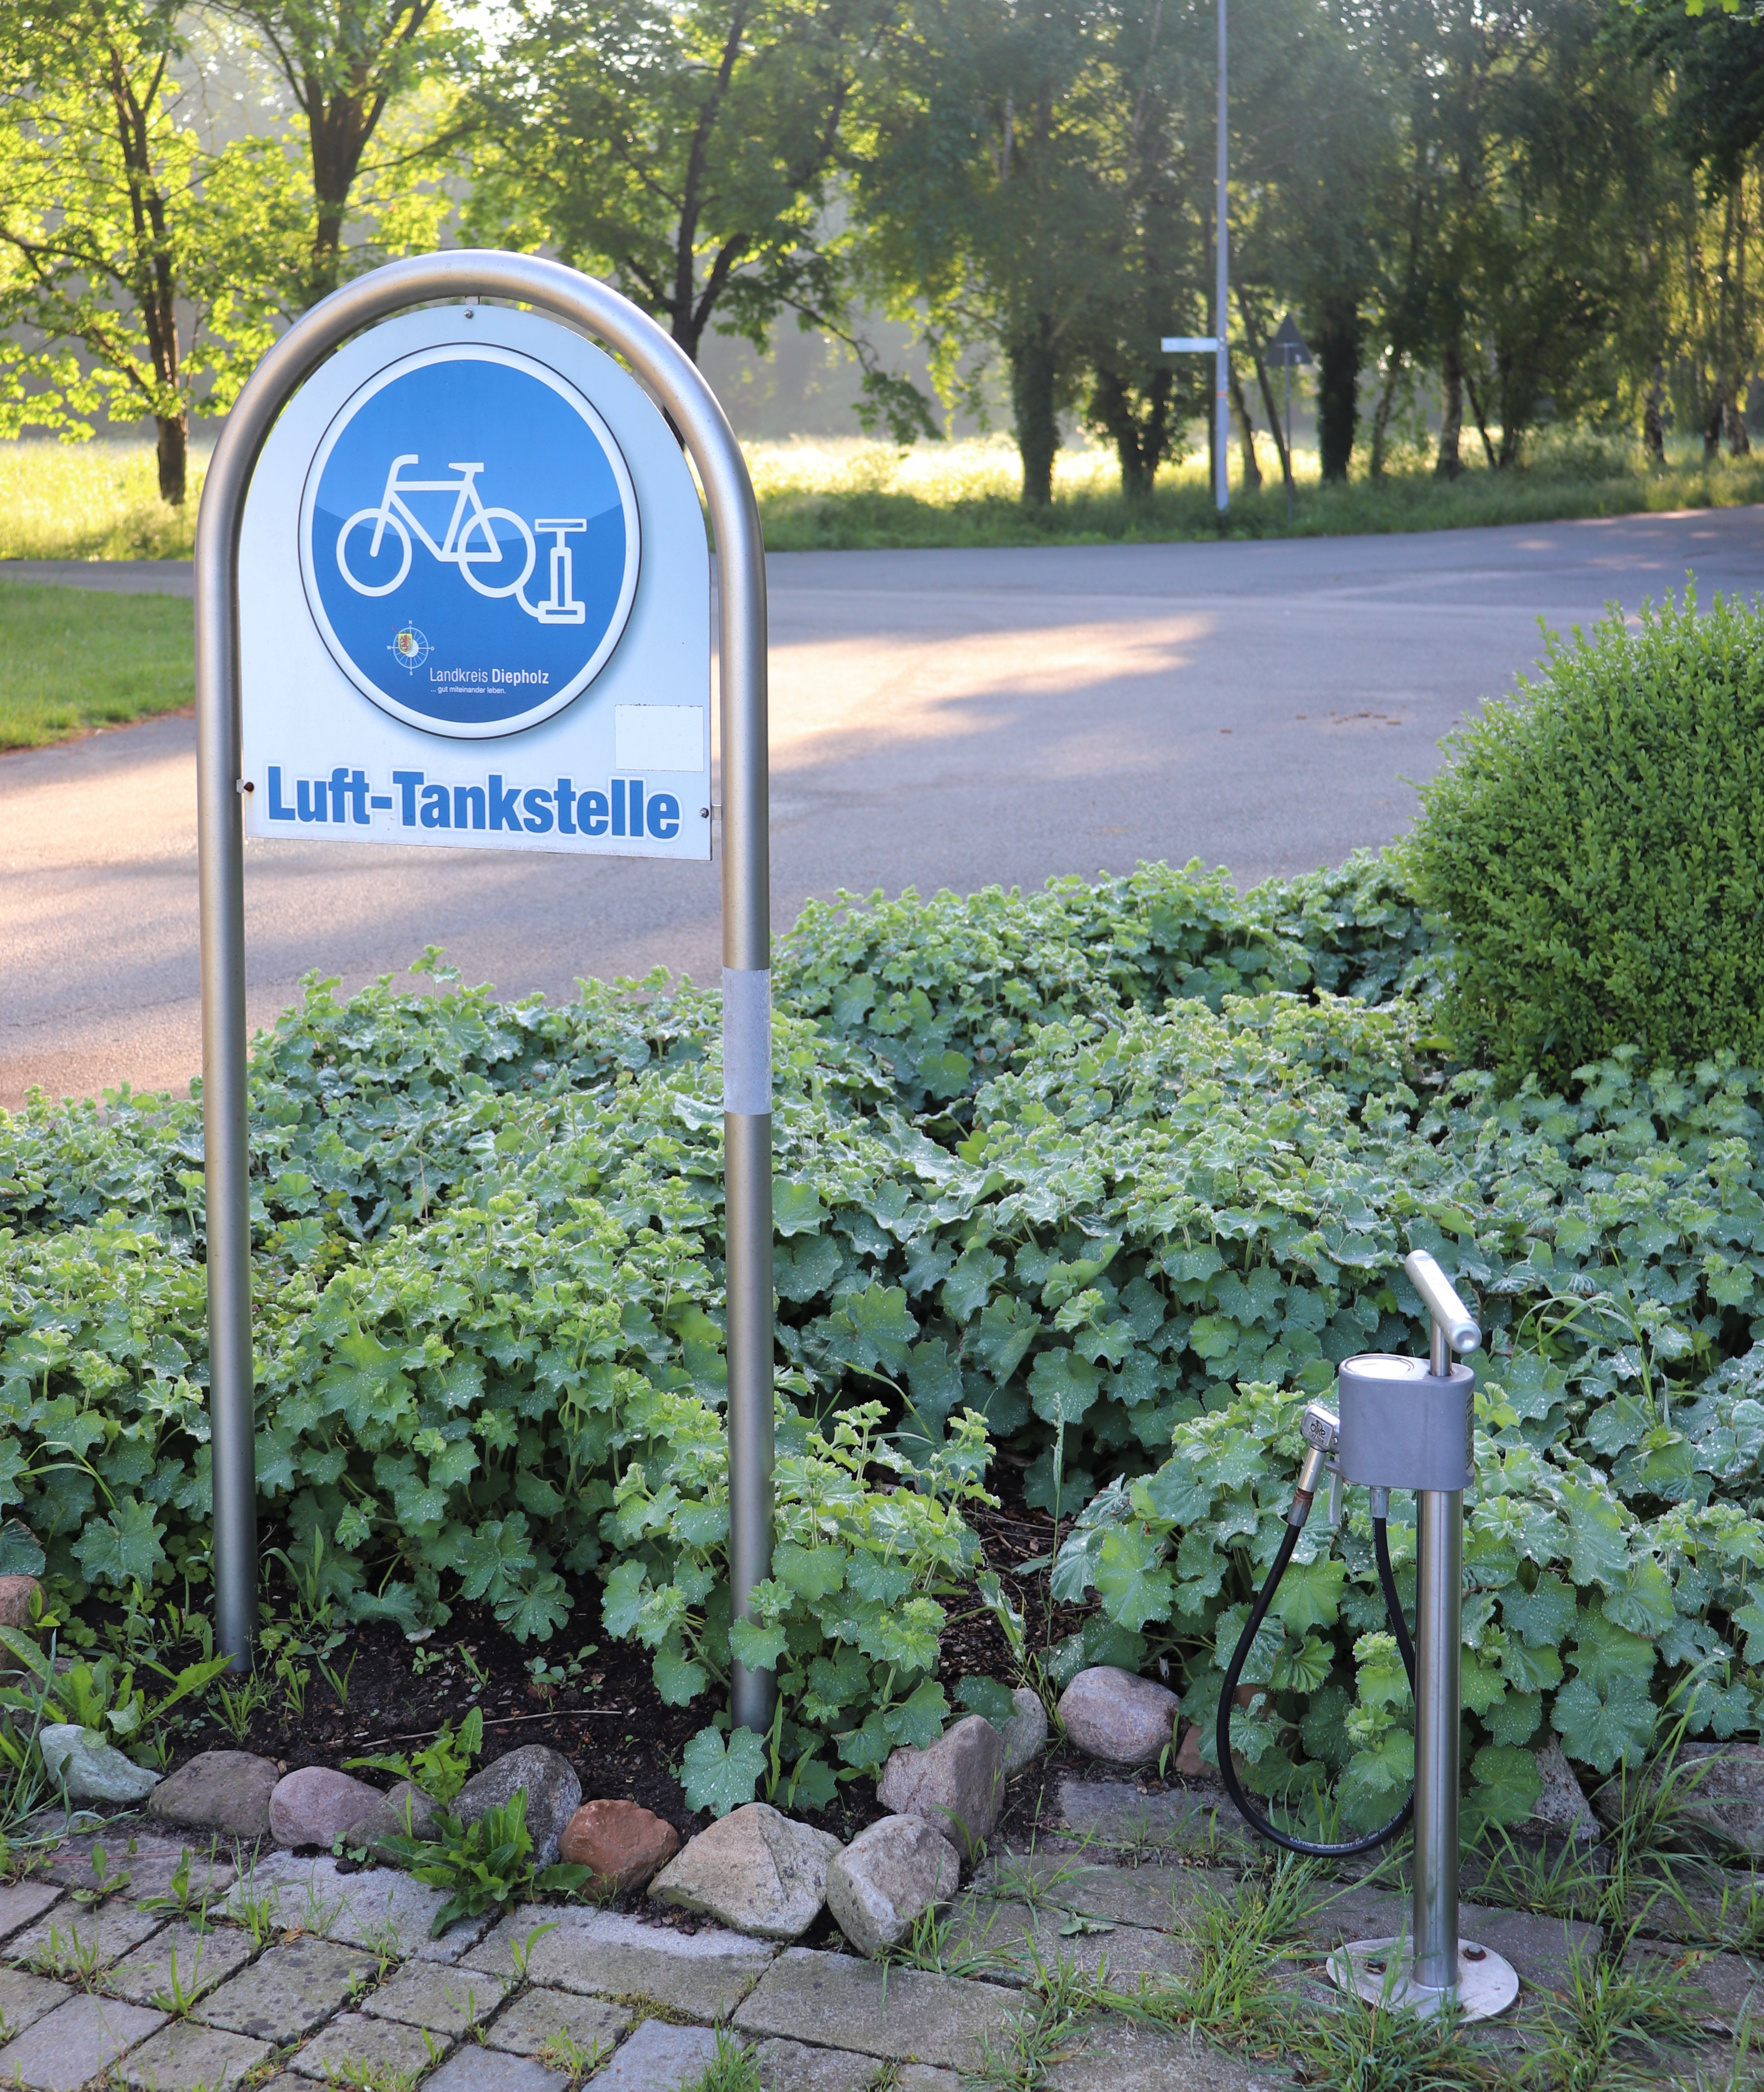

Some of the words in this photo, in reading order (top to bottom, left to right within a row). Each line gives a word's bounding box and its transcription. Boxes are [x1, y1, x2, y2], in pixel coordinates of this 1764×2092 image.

[429, 667, 488, 683] Landkreis
[491, 668, 549, 687] Diepholz
[437, 686, 449, 694] gut
[449, 685, 486, 694] miteinander
[267, 765, 681, 839] Luft-Tankstelle
[1289, 1836, 1314, 1848] RAPTOR
